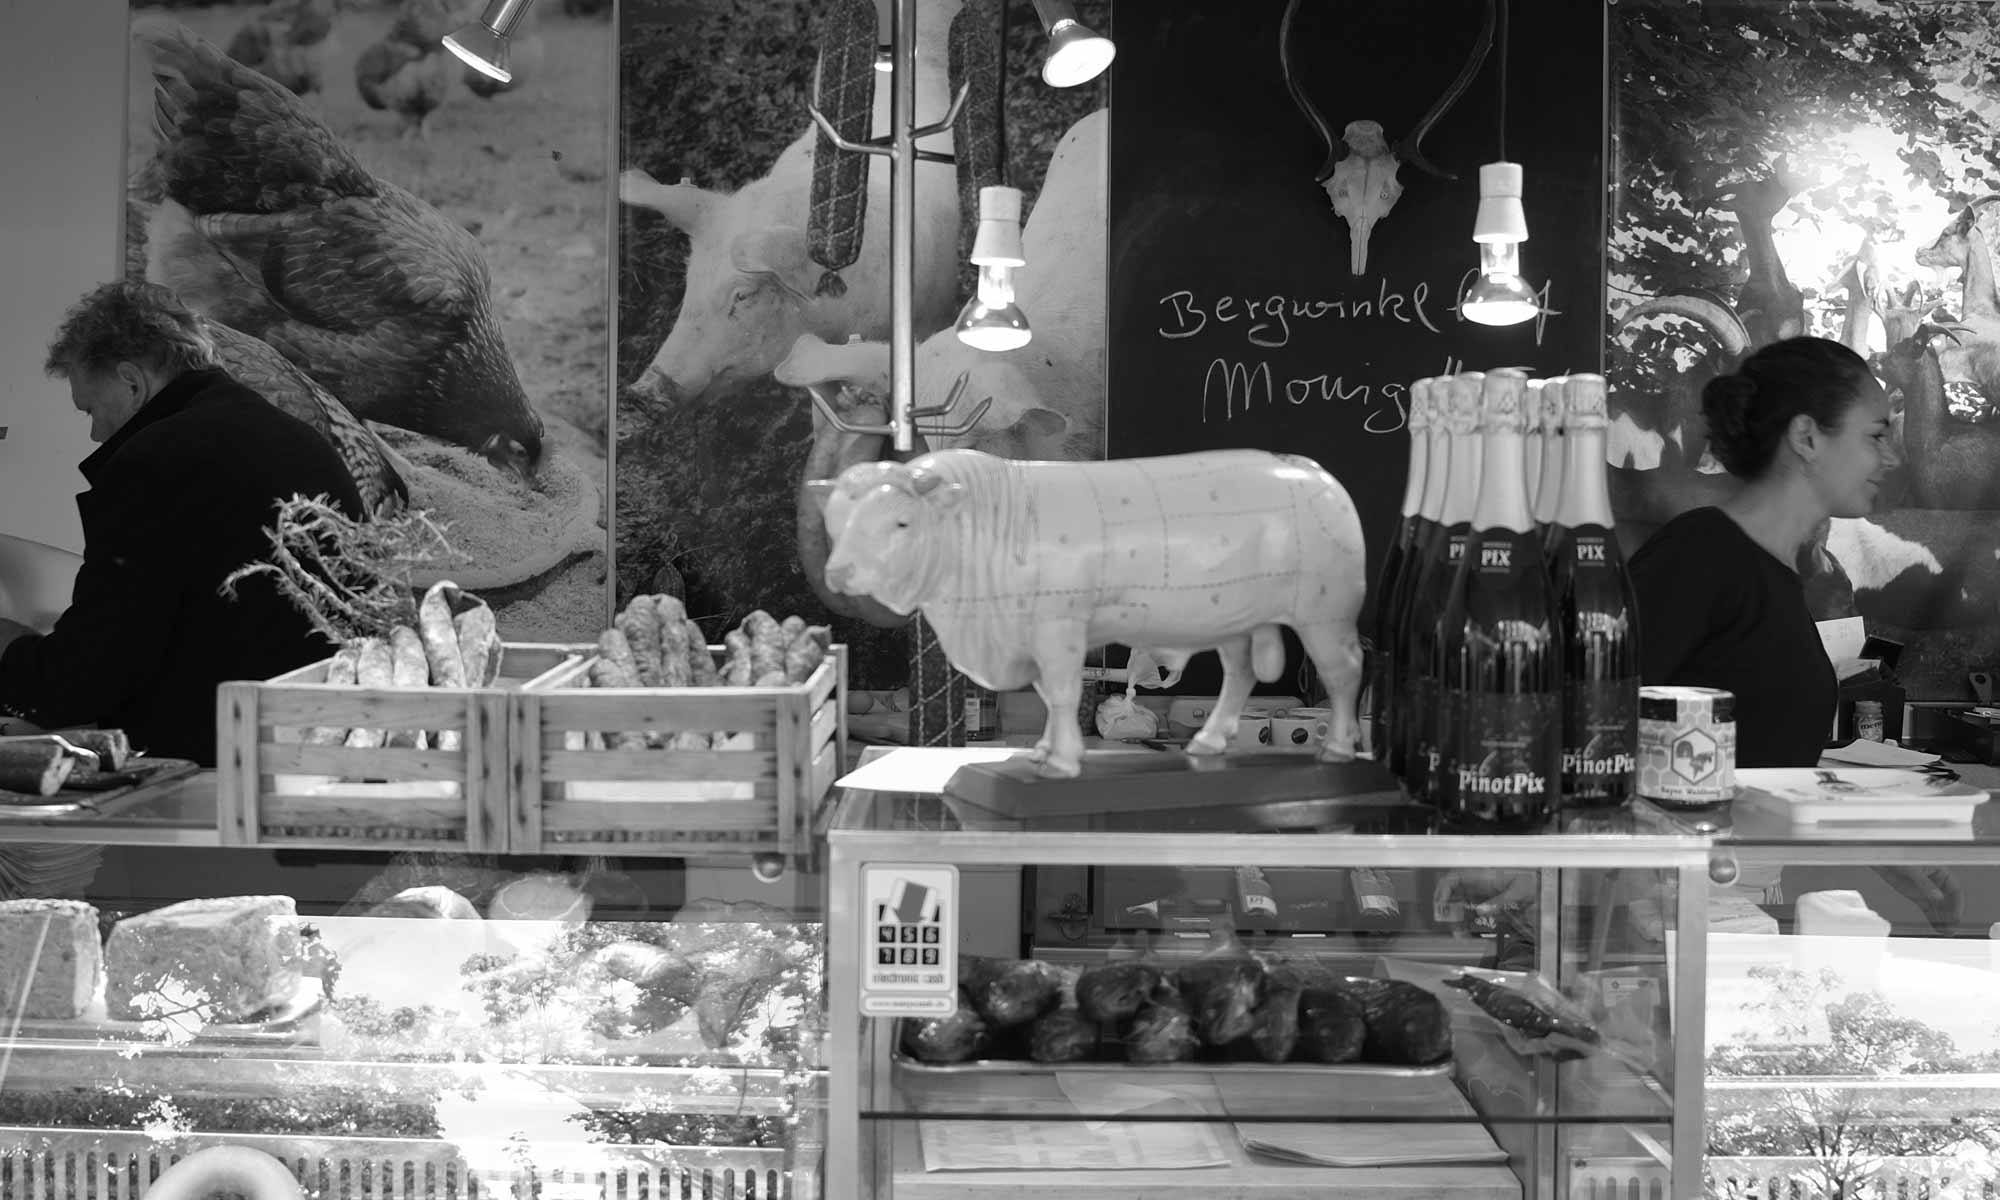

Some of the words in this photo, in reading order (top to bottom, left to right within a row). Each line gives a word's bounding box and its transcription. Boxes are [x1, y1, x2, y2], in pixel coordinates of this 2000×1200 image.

[1449, 542, 1466, 559] PI
[1481, 549, 1512, 567] PIX
[1577, 544, 1605, 561] PIX
